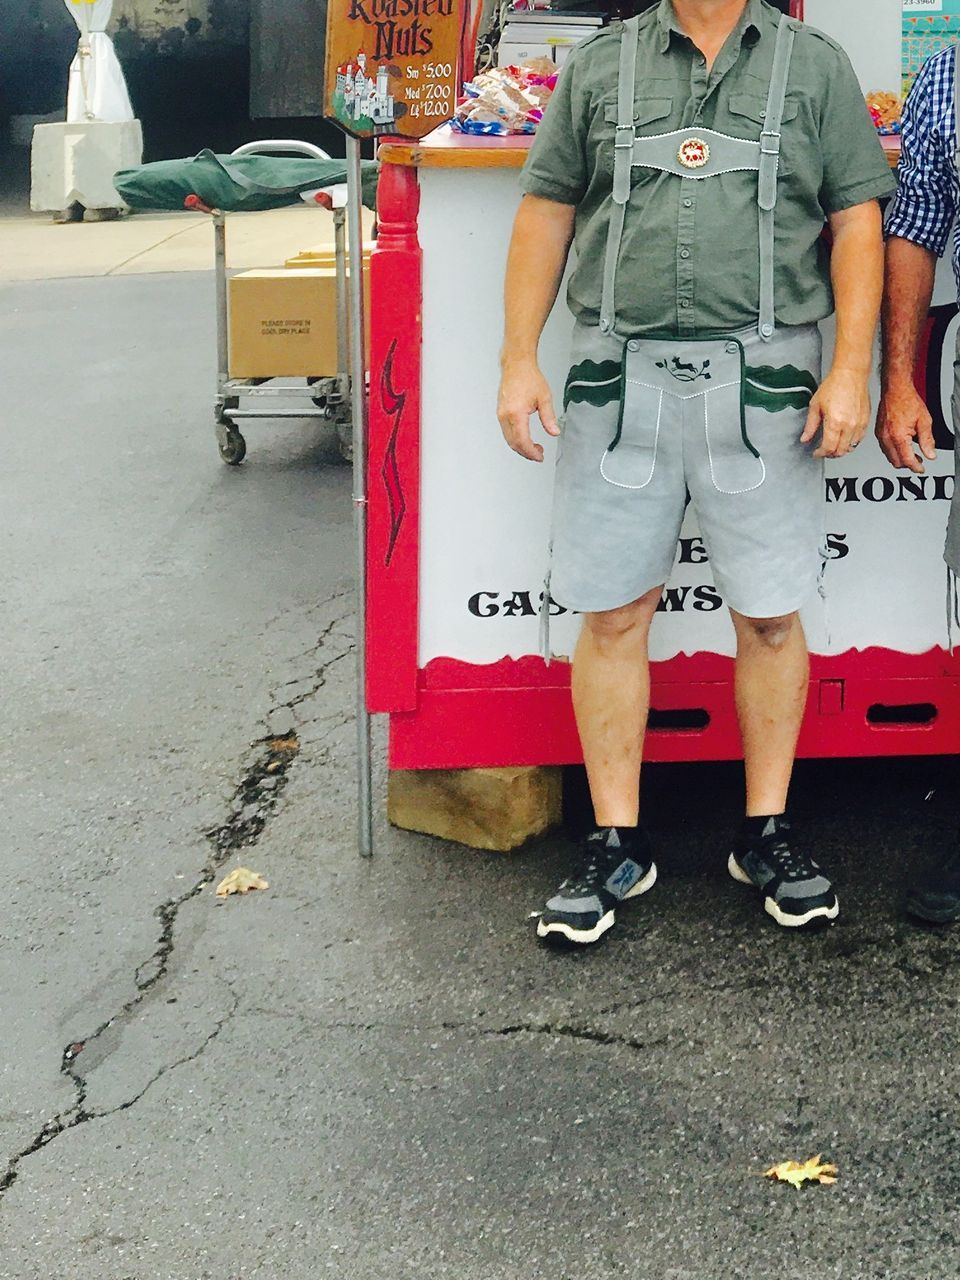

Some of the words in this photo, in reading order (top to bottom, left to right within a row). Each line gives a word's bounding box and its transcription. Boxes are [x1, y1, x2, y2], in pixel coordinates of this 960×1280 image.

[371, 19, 433, 61] Nuts
[406, 65, 419, 79] Sm
[422, 63, 451, 78] $5.00
